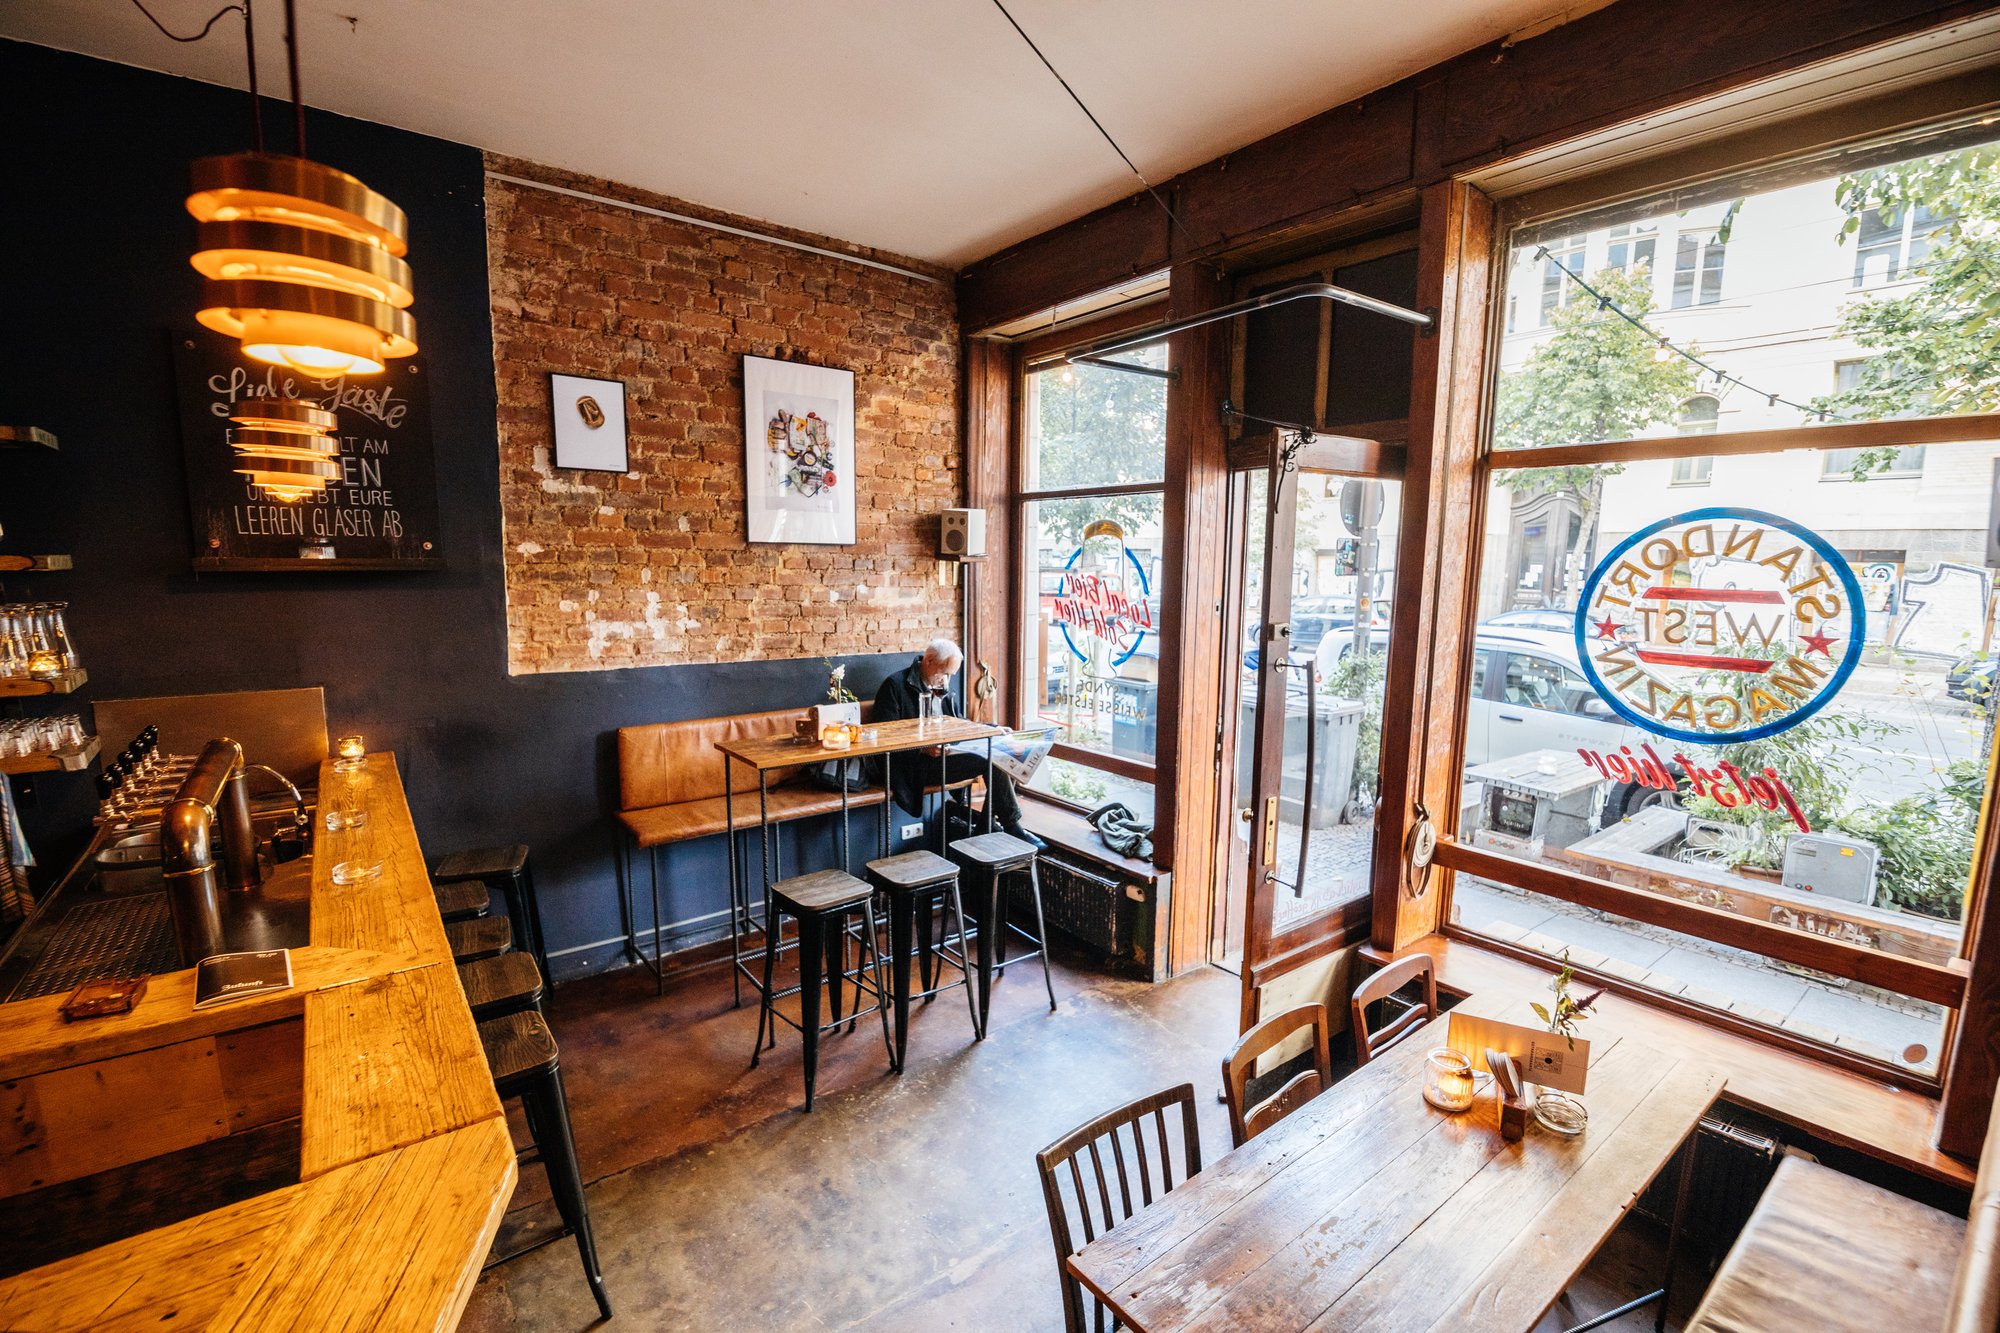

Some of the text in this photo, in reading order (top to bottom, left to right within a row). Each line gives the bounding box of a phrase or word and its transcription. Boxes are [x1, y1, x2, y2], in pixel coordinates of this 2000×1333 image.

[363, 439, 389, 455] AM
[350, 489, 393, 507] EURE
[234, 505, 403, 538] LEEREN GLÄSER AB
